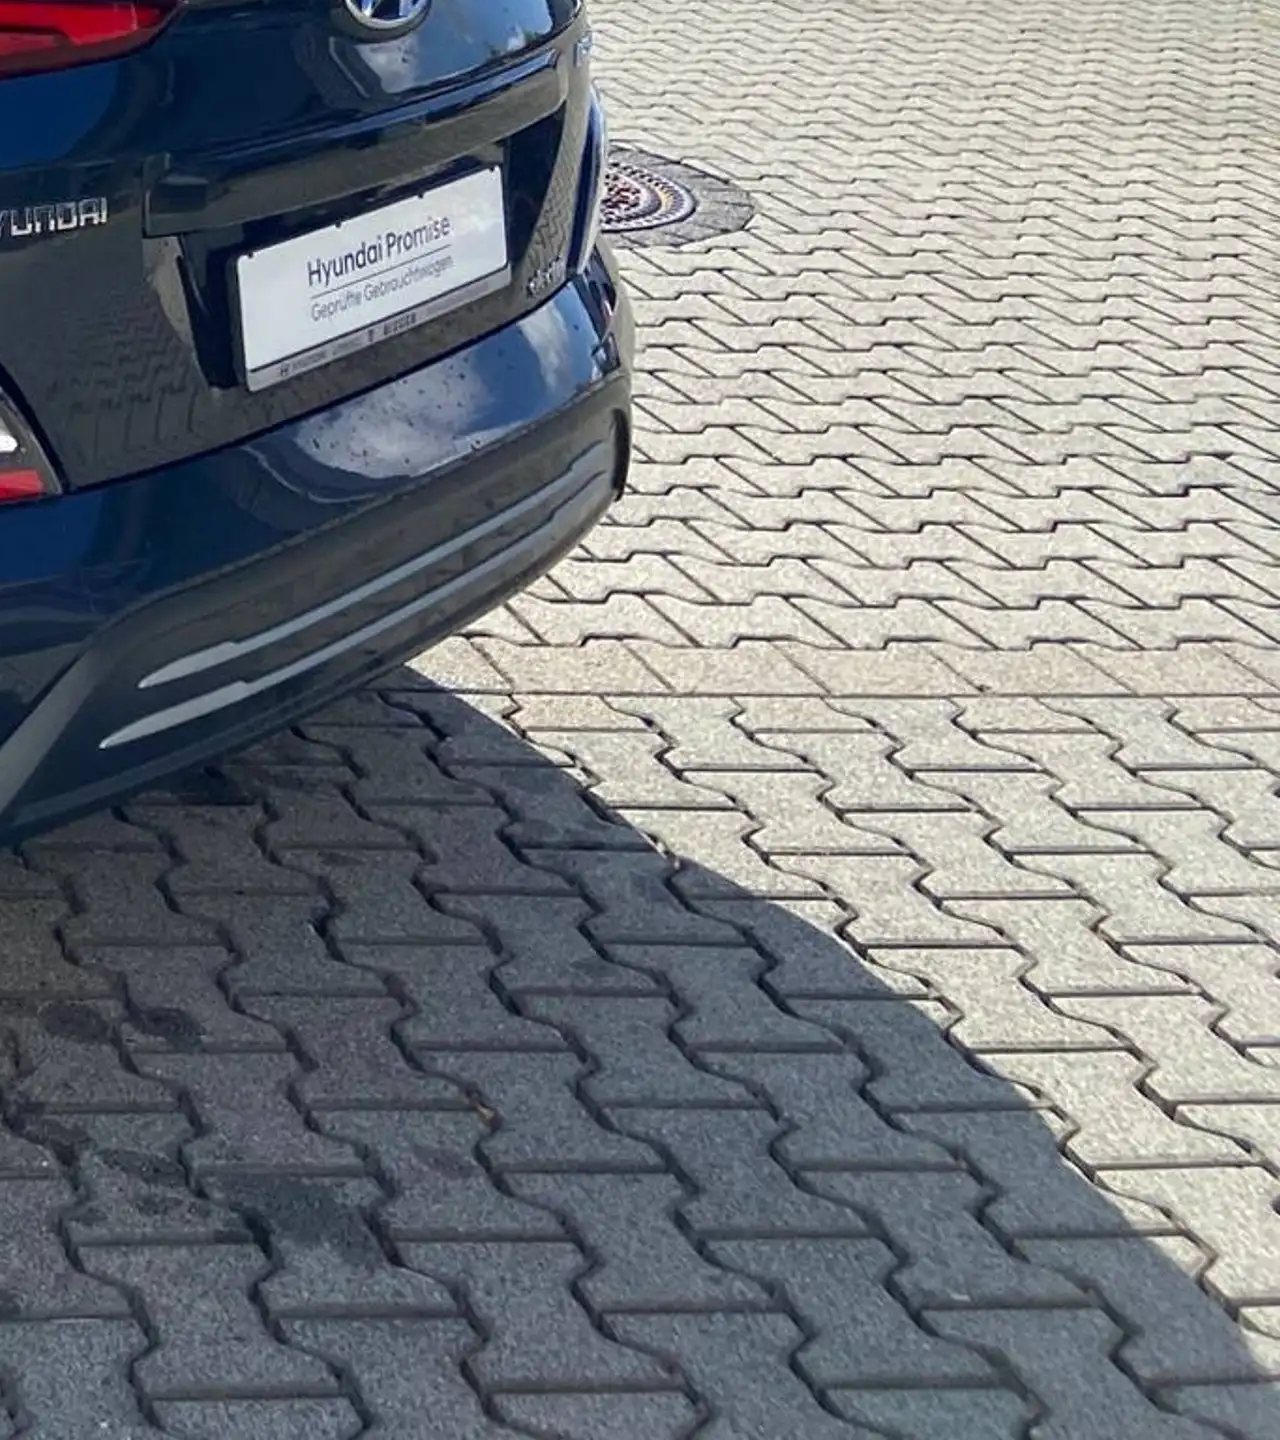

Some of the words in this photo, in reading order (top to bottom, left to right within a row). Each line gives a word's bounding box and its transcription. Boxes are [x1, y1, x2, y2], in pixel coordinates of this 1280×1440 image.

[307, 234, 384, 287] Hyundai
[385, 216, 451, 257] Promise
[310, 288, 362, 322] Geprüfte
[363, 255, 454, 302] Gebrauchtwagen
